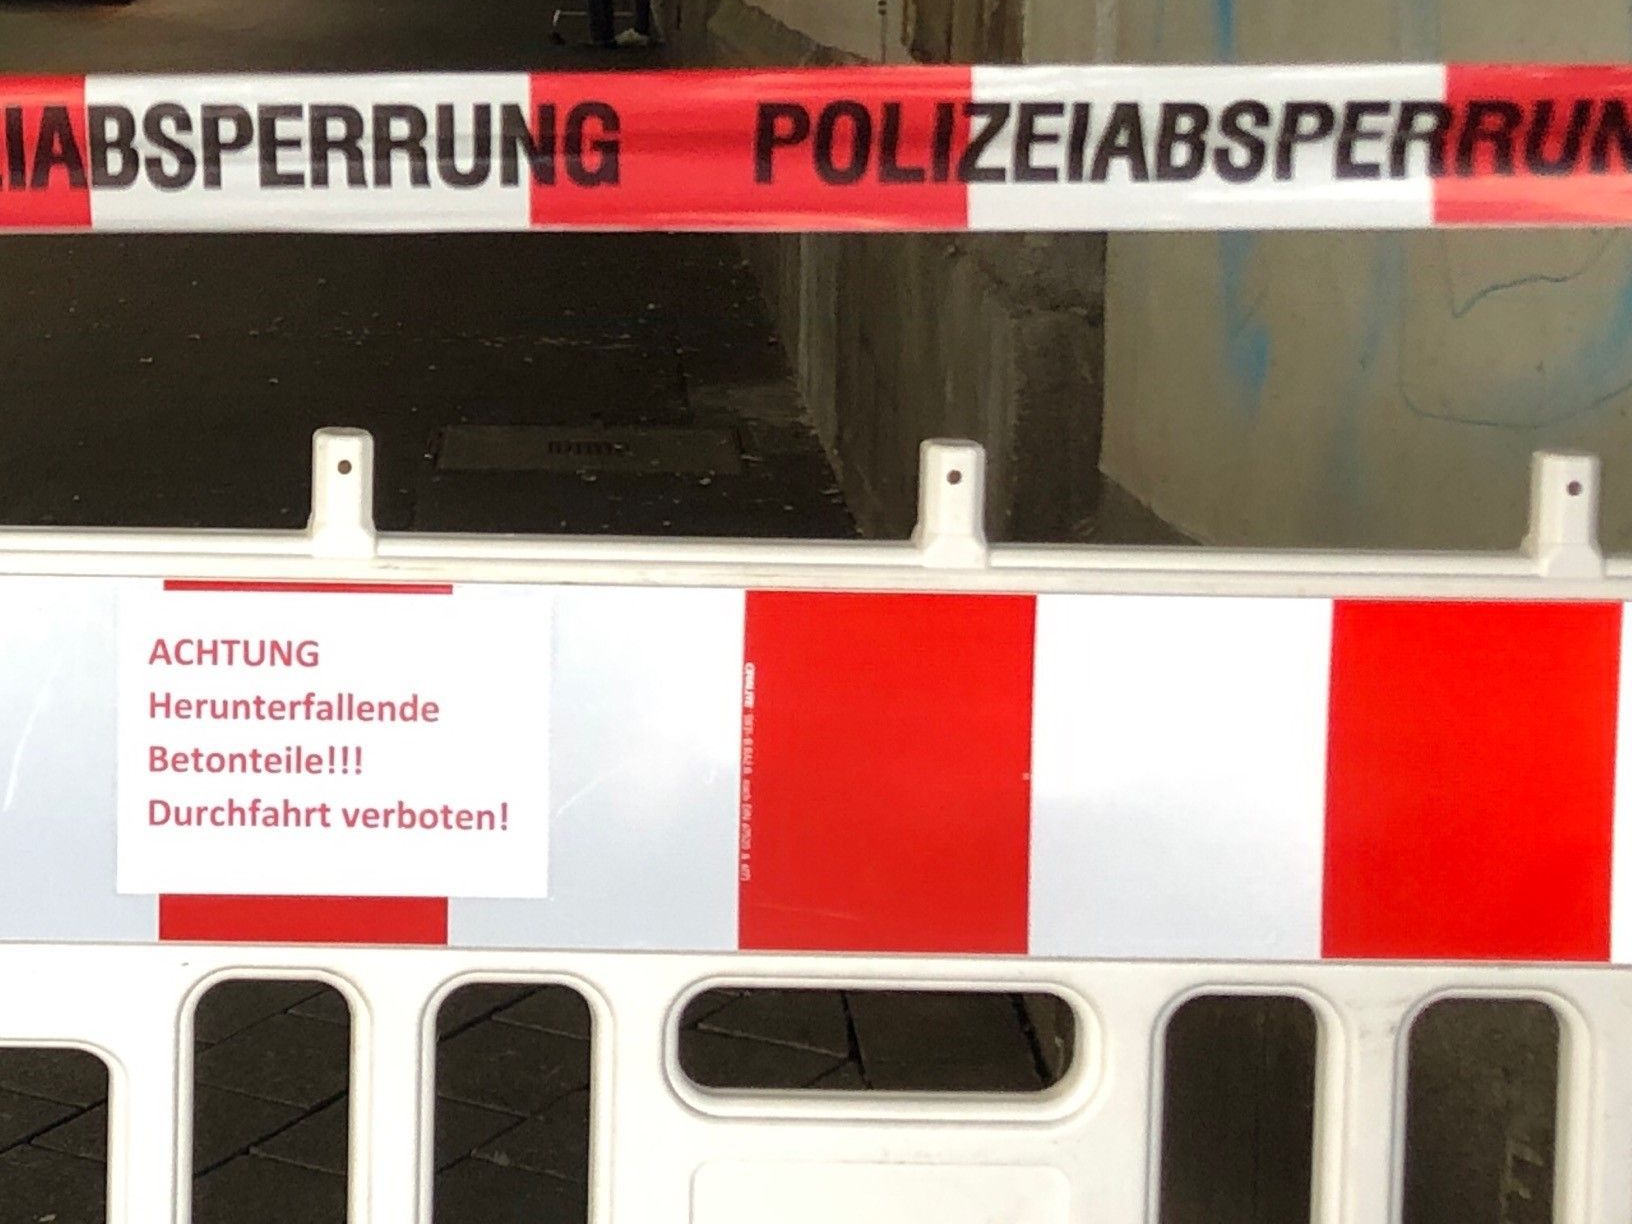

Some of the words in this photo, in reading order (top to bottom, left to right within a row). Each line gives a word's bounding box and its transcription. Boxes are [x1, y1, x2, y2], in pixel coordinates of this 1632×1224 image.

[148, 638, 320, 668] ACHTUNG
[148, 691, 441, 723] Herunterfallende
[148, 745, 364, 775] Betonteile!!!
[147, 798, 332, 828] Durchfahrt
[341, 800, 509, 832] verboten!
